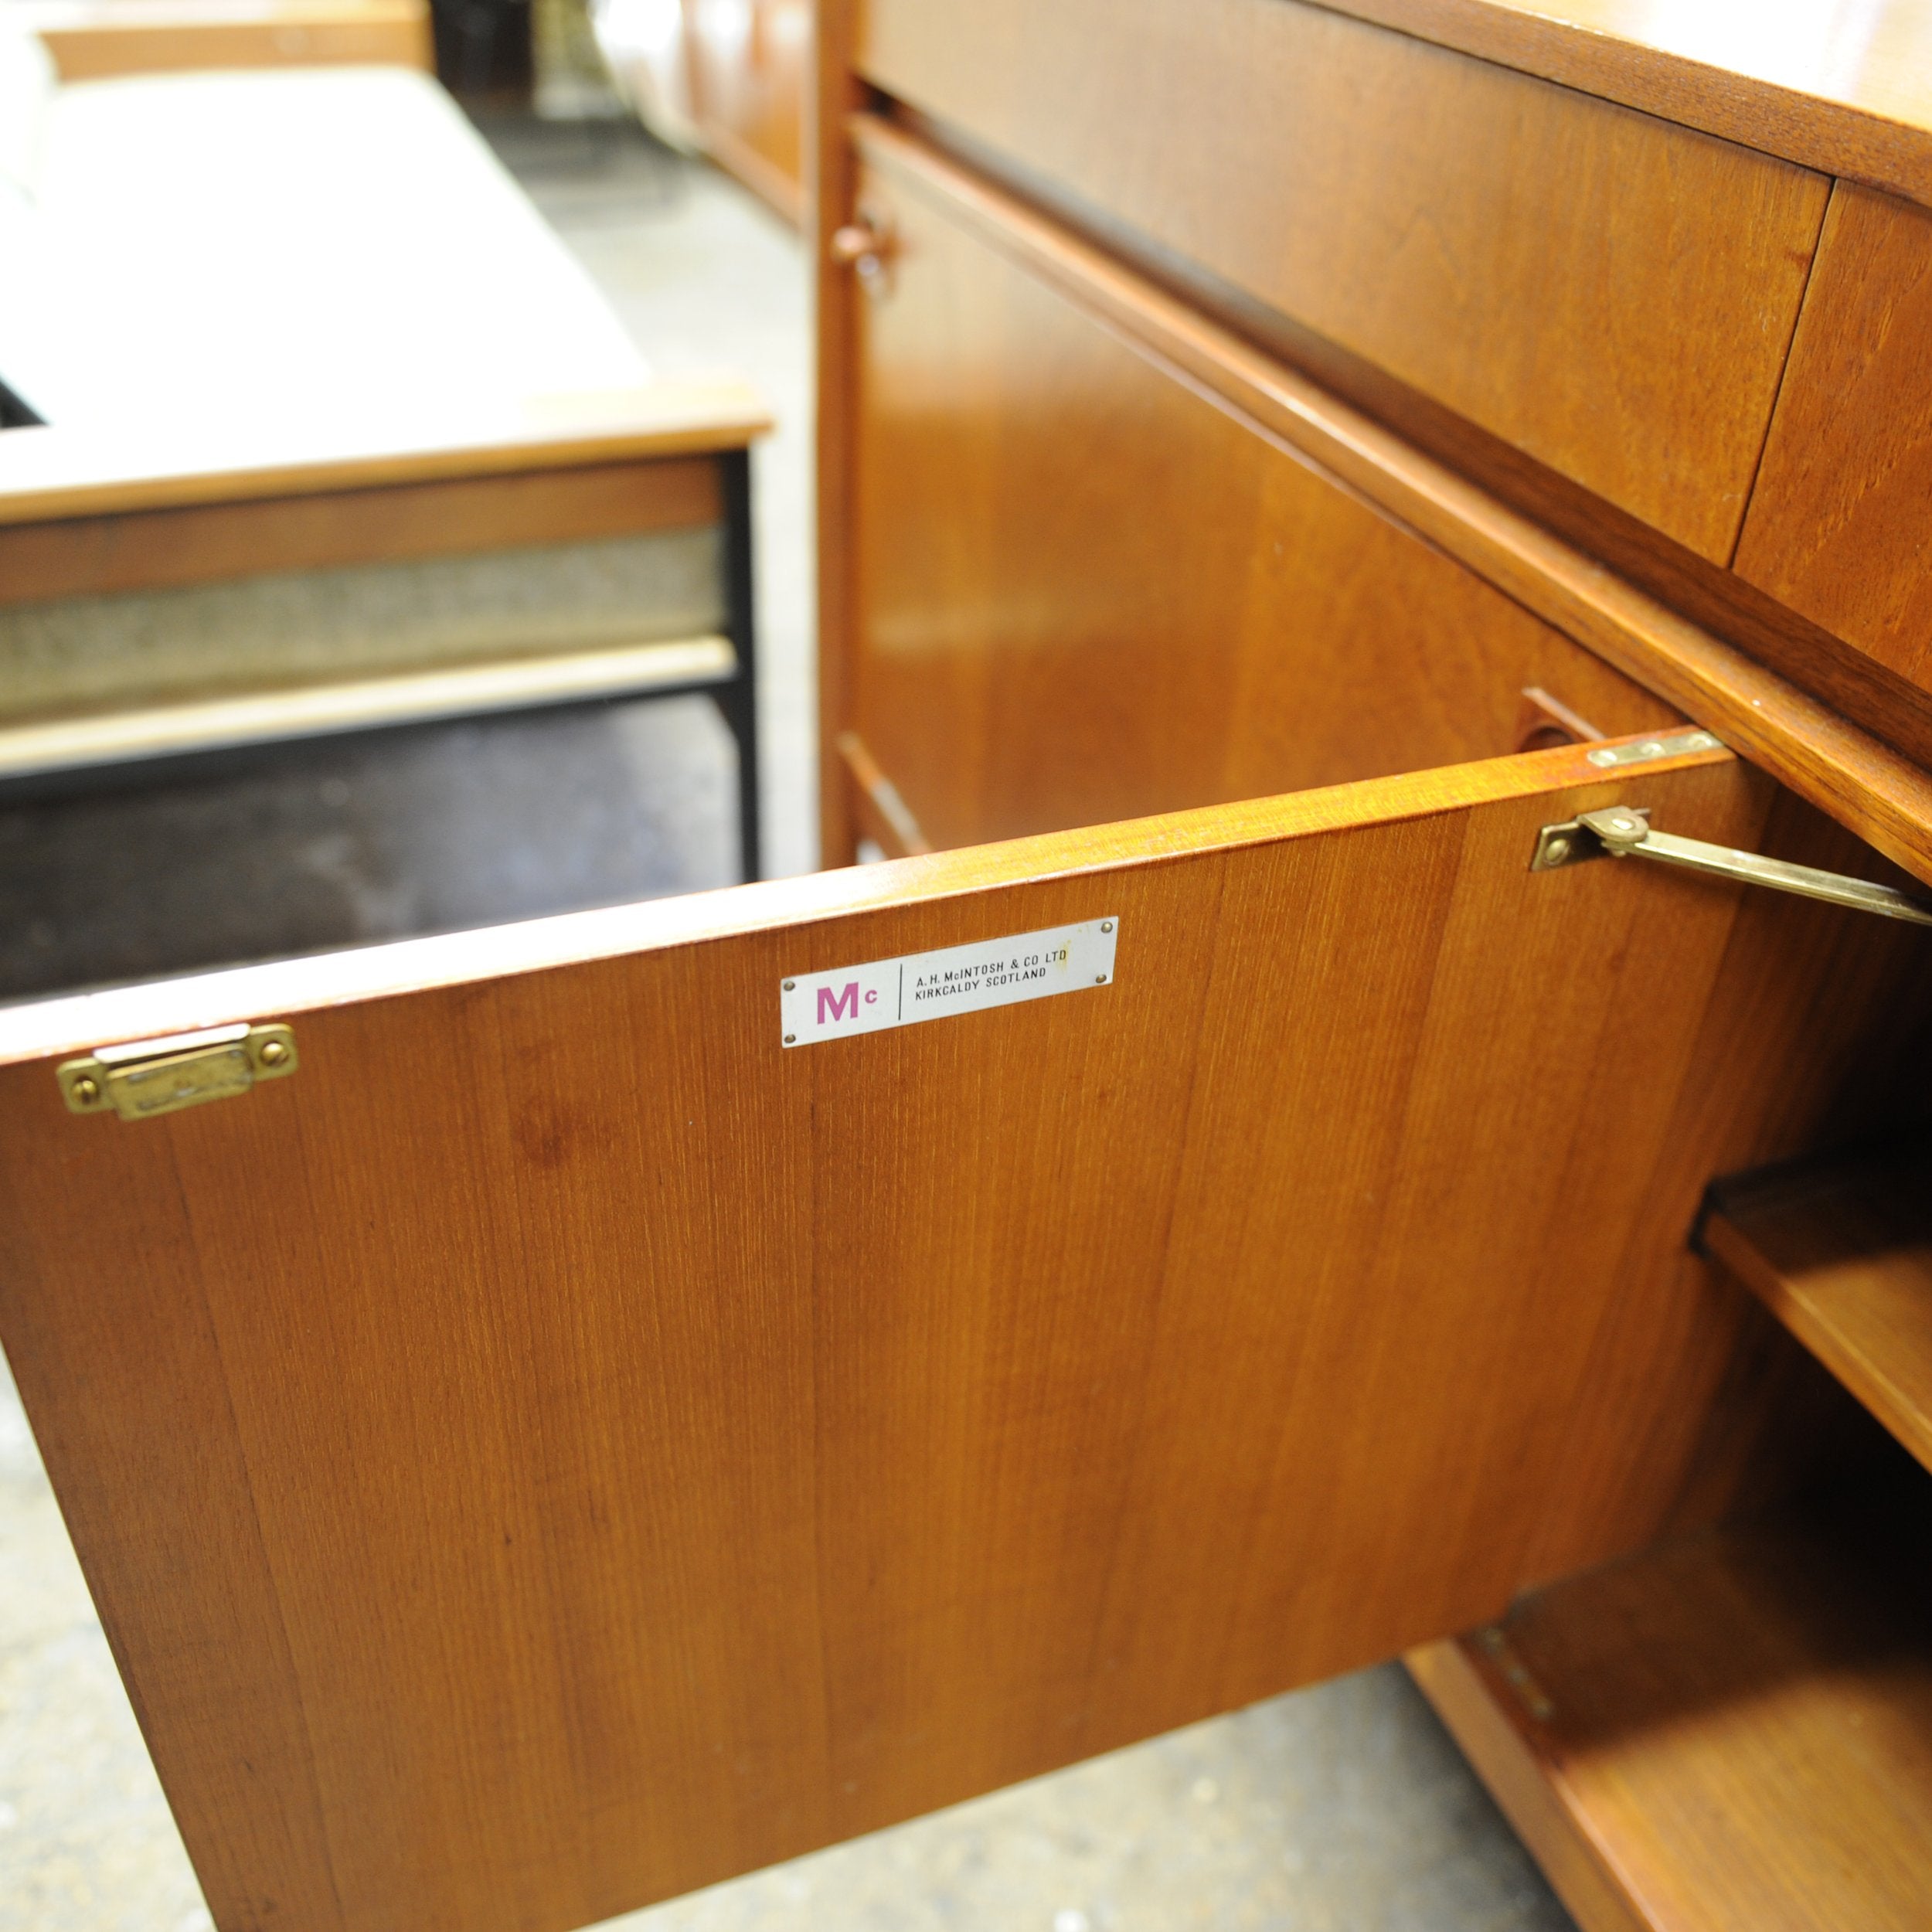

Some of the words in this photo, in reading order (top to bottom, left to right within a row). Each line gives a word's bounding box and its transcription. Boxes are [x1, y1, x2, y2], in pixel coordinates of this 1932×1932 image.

[944, 961, 1004, 982] McINTOSH
[1011, 958, 1019, 969] &
[1024, 955, 1039, 967] CO
[1046, 949, 1066, 963] LTD
[915, 979, 980, 1001] KIRKCALDY
[986, 967, 1046, 988] SCOTLAND
[816, 981, 878, 1025] Mc
